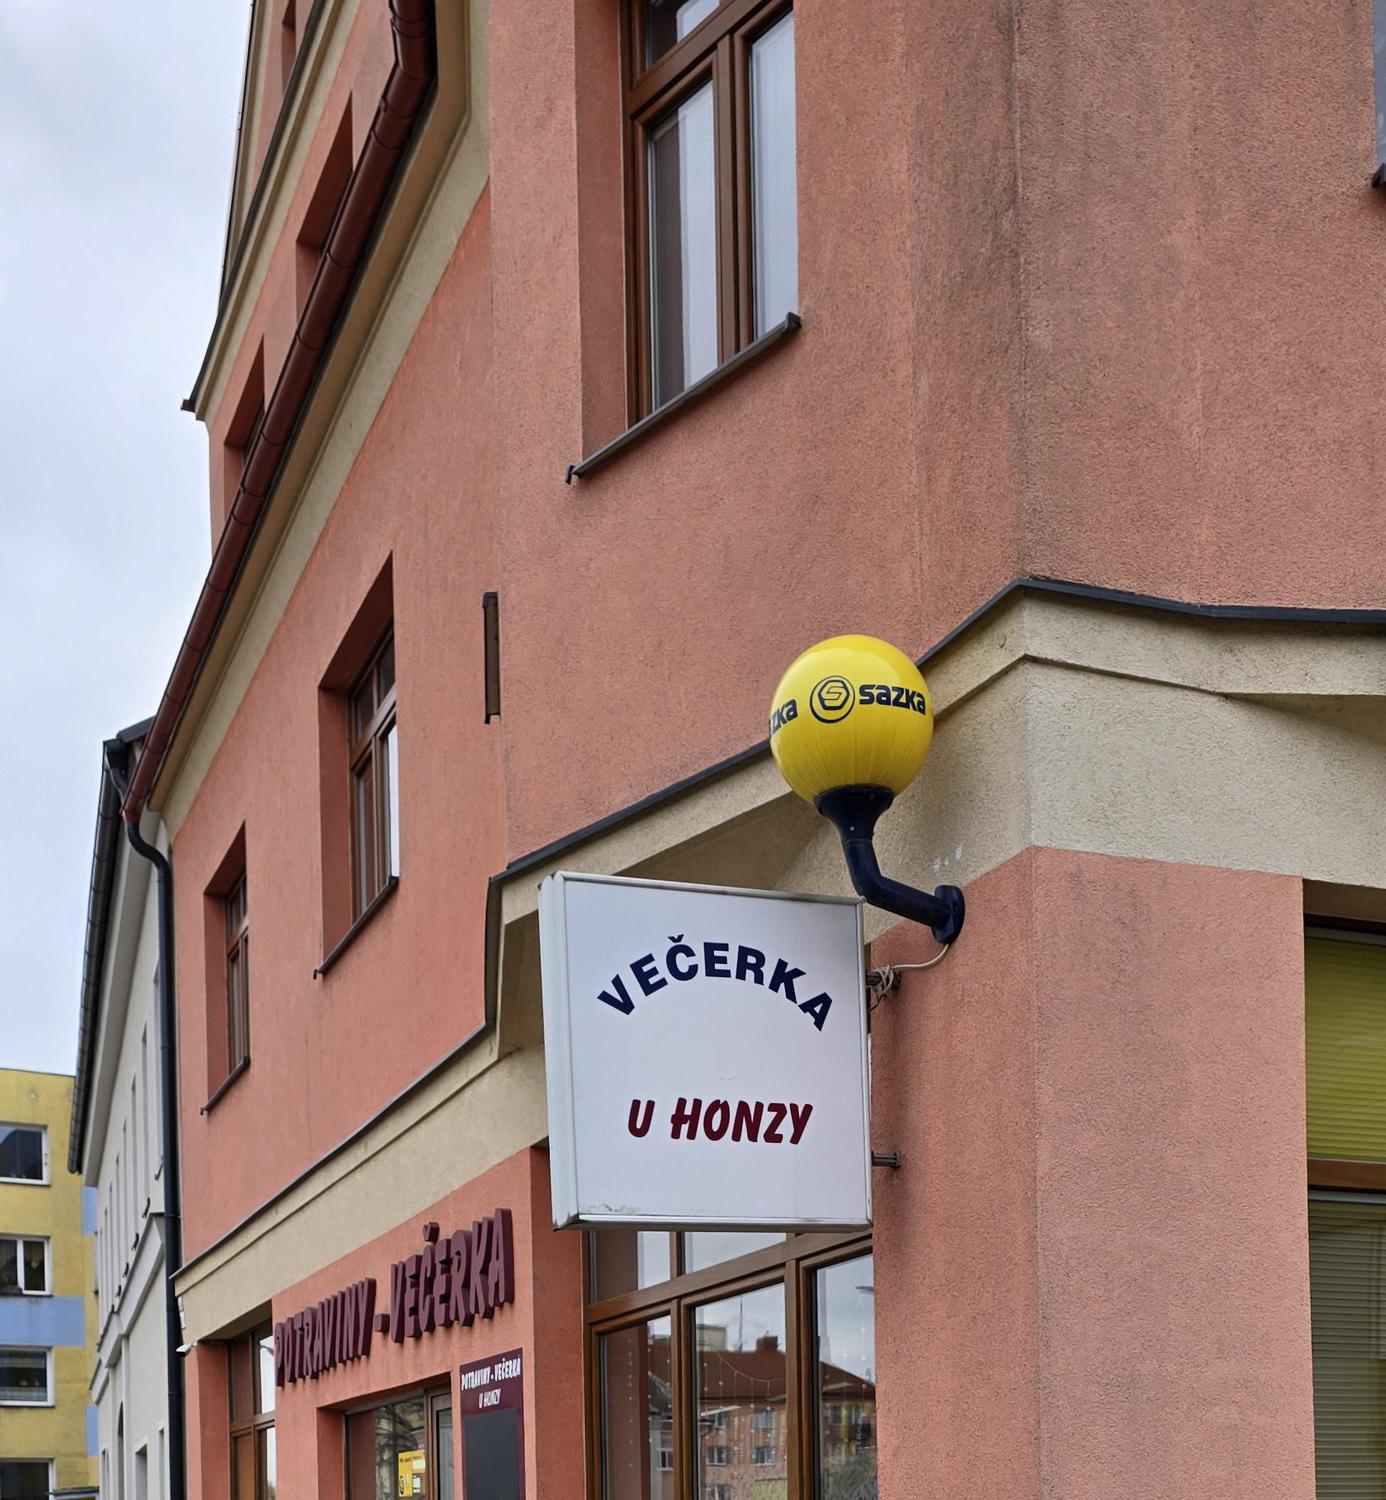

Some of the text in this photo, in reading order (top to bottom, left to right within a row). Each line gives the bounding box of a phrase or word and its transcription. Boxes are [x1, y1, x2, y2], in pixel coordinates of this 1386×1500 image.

[769, 698, 798, 735] zka
[597, 934, 833, 1032] VEČERKA
[627, 1097, 814, 1145] U HONZY
[274, 1277, 377, 1387] POTRAVINY
[390, 1207, 514, 1343] VEČERKA
[461, 1367, 491, 1391] POTRAVINY
[479, 1388, 501, 1408] U HONZY
